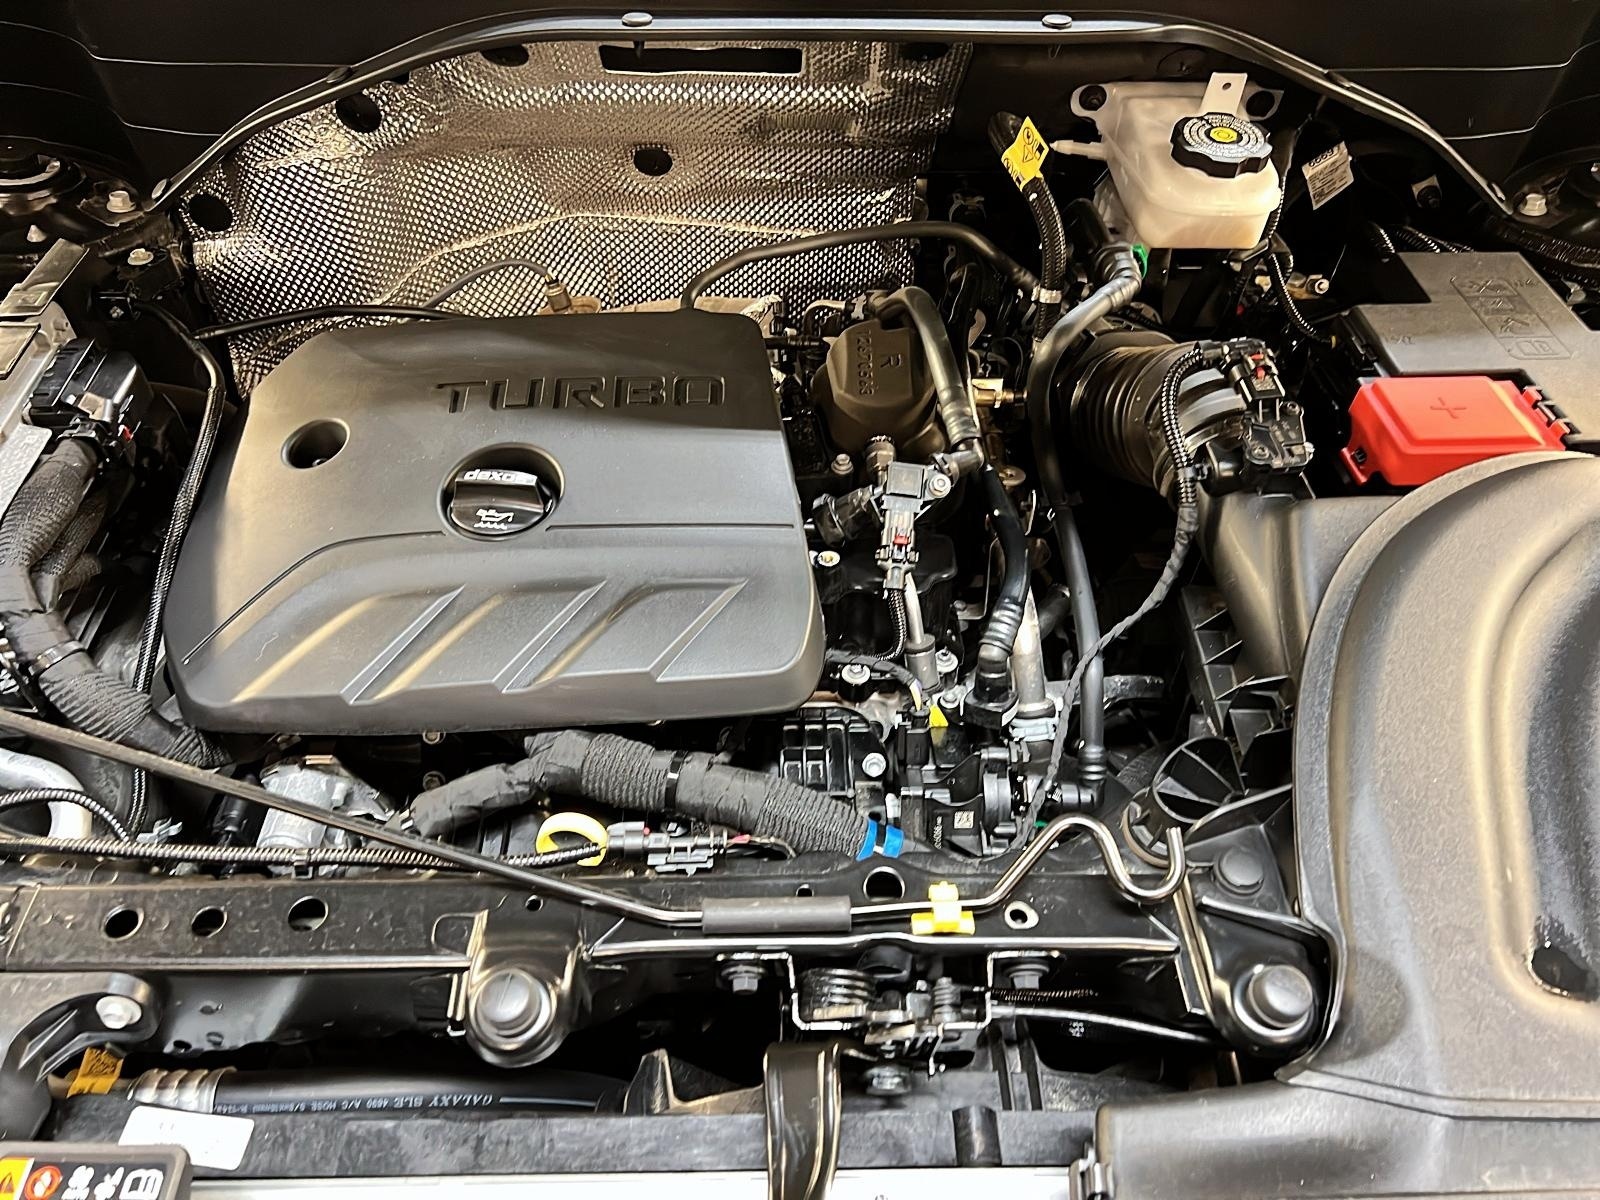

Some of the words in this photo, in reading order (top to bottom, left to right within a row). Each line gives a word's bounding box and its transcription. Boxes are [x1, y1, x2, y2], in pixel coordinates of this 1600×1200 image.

[435, 375, 726, 414] TURBO
[310, 1101, 337, 1113] HOSE
[341, 1098, 362, 1111] A/C
[429, 1094, 493, 1107] GALAXY
